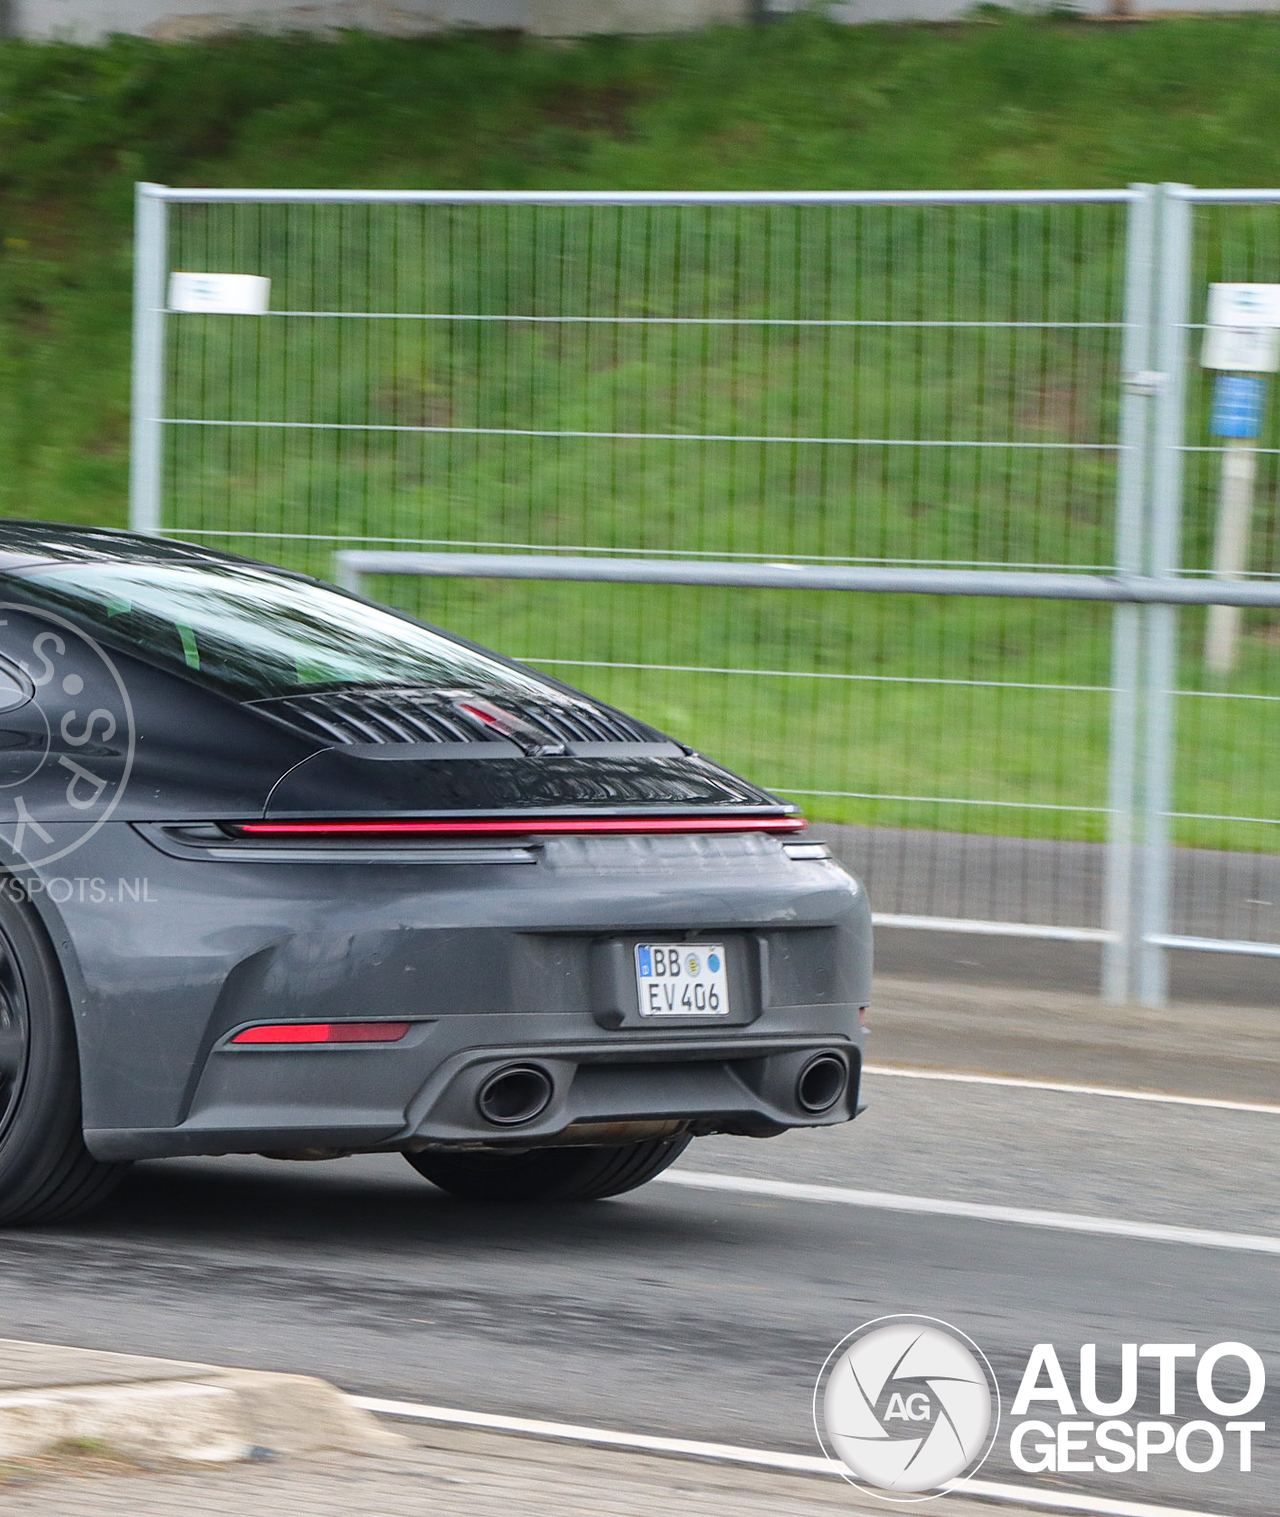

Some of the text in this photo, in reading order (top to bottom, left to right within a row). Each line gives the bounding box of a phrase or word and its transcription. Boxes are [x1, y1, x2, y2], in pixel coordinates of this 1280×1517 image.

[653, 948, 681, 978] BB
[648, 983, 720, 1012] EV 406
